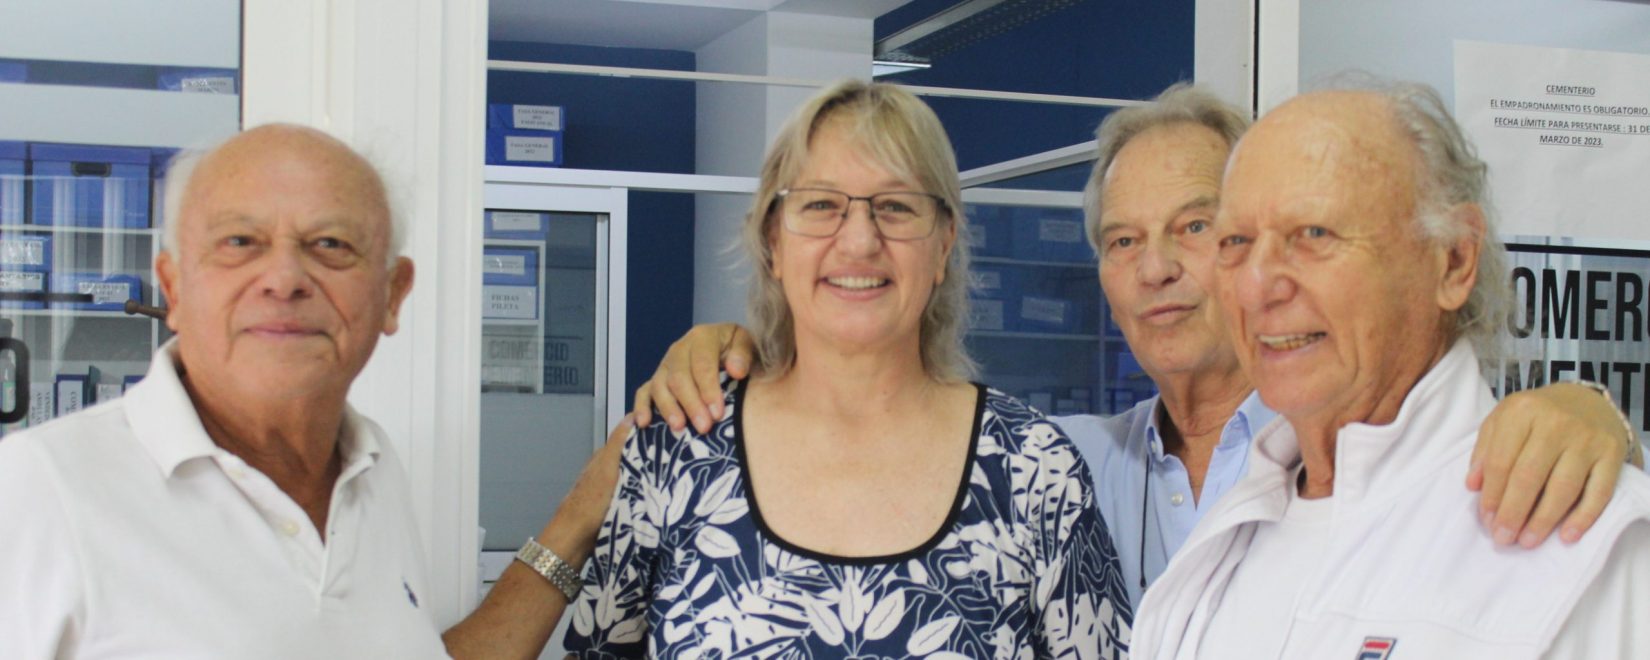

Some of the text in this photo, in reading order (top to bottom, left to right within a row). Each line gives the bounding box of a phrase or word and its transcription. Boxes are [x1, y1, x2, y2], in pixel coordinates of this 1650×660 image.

[1546, 85, 1595, 95] CEMENTERIO
[1490, 99, 1498, 108] EL
[1500, 100, 1581, 112] EMPADRONAMIENTO
[1583, 105, 1592, 113] ES
[1494, 117, 1519, 126] FECHA
[1520, 117, 1546, 128] LÍMITE
[1548, 120, 1569, 129] PARA
[1571, 121, 1621, 132] PRESENTARSE
[1628, 125, 1637, 133] 31
[1640, 125, 1650, 133] DE
[1539, 135, 1570, 144] MARZO
[1572, 136, 1582, 145] DE
[1507, 267, 1650, 342] OMER
